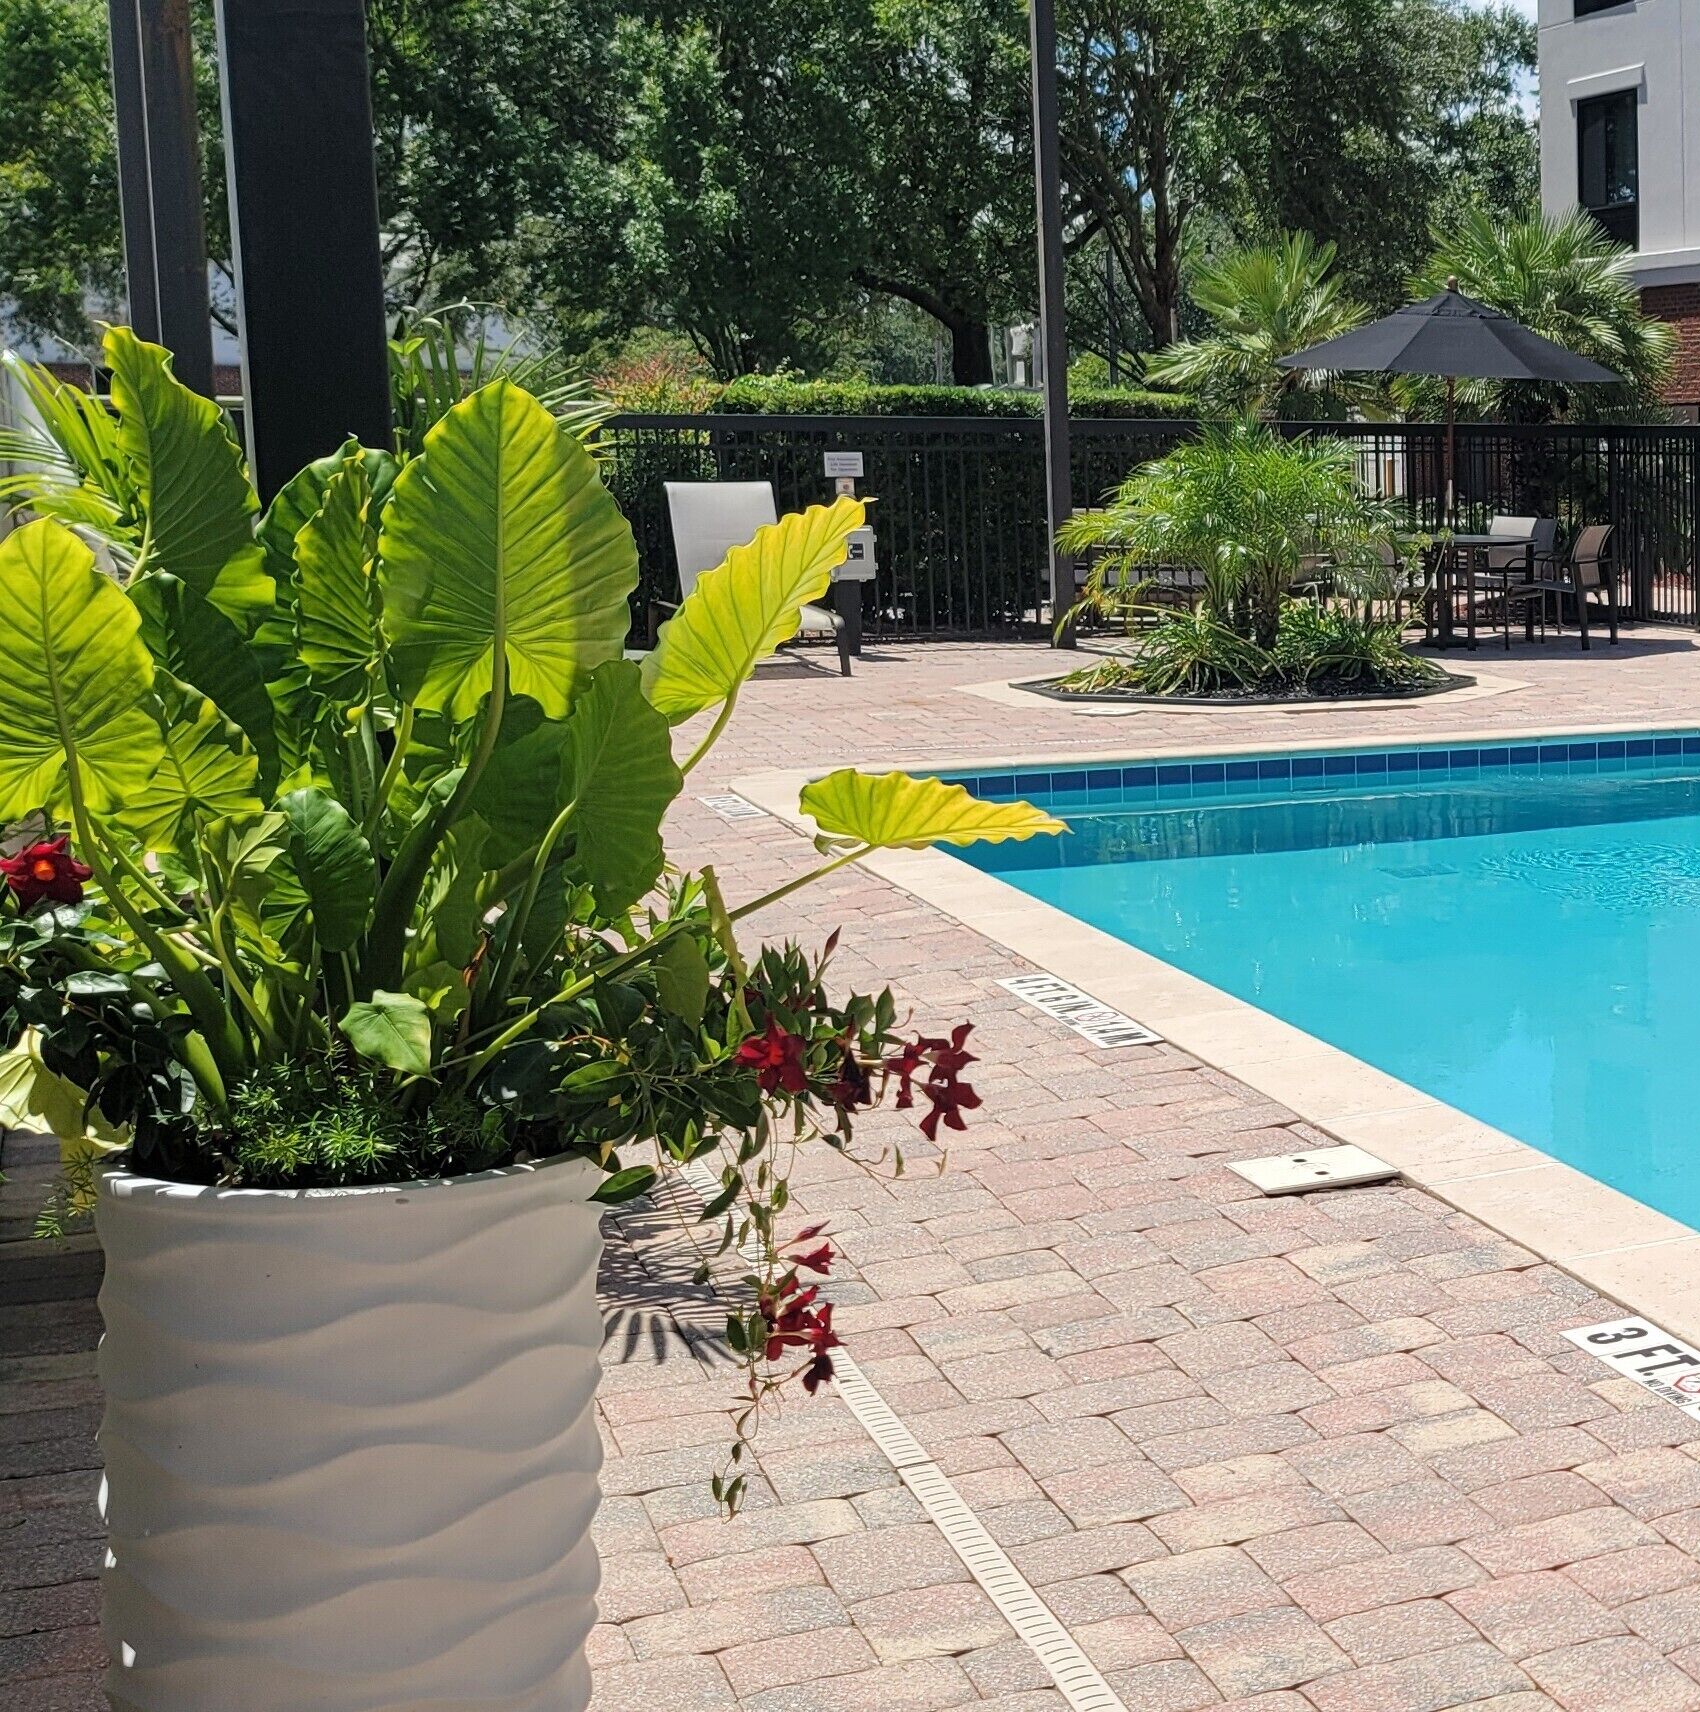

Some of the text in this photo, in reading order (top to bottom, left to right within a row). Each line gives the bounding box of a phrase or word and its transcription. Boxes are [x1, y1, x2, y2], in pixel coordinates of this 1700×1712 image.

[1009, 977, 1049, 985] 4
[1037, 994, 1079, 1003] 6
[1586, 1326, 1649, 1345] 3
